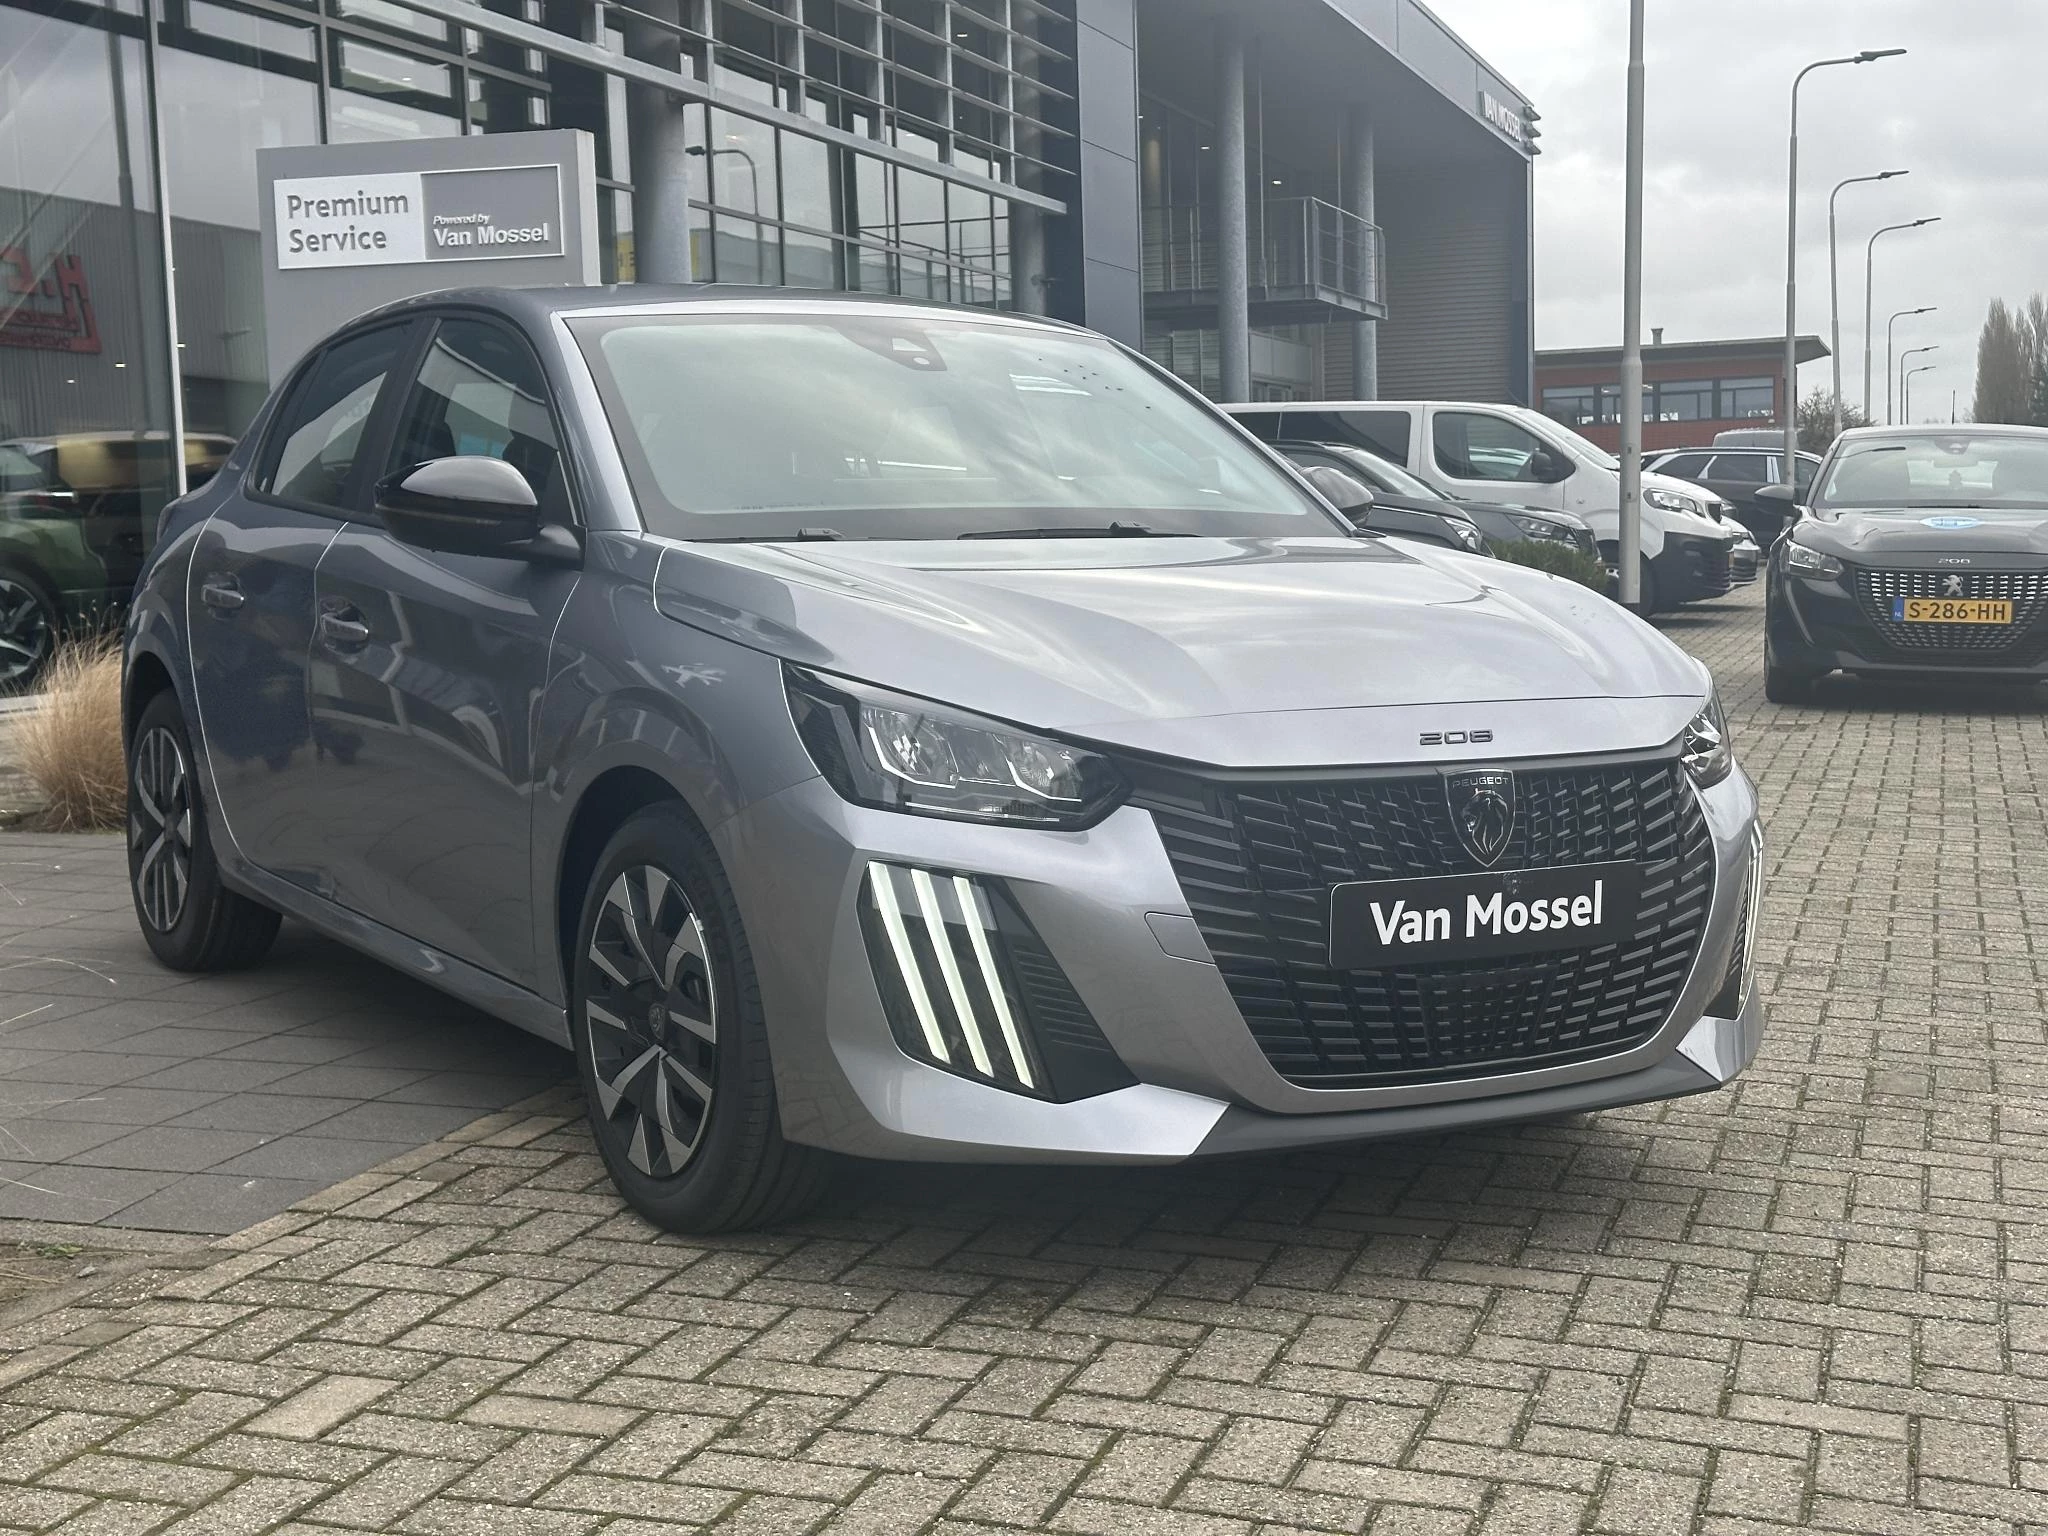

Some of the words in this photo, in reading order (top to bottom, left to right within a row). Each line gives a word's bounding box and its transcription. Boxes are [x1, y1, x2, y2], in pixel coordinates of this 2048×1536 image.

[287, 190, 409, 219] Premium
[433, 214, 476, 225] Powered
[477, 213, 490, 225] by
[288, 225, 387, 253] Service
[433, 227, 472, 247] Van
[477, 223, 549, 245] Mossel
[1908, 602, 2005, 620] S-286-HH
[1419, 729, 1494, 746] 208
[1452, 776, 1509, 788] PEUGEOT
[1369, 900, 1450, 945] Van
[1465, 879, 1603, 938] Mossel
